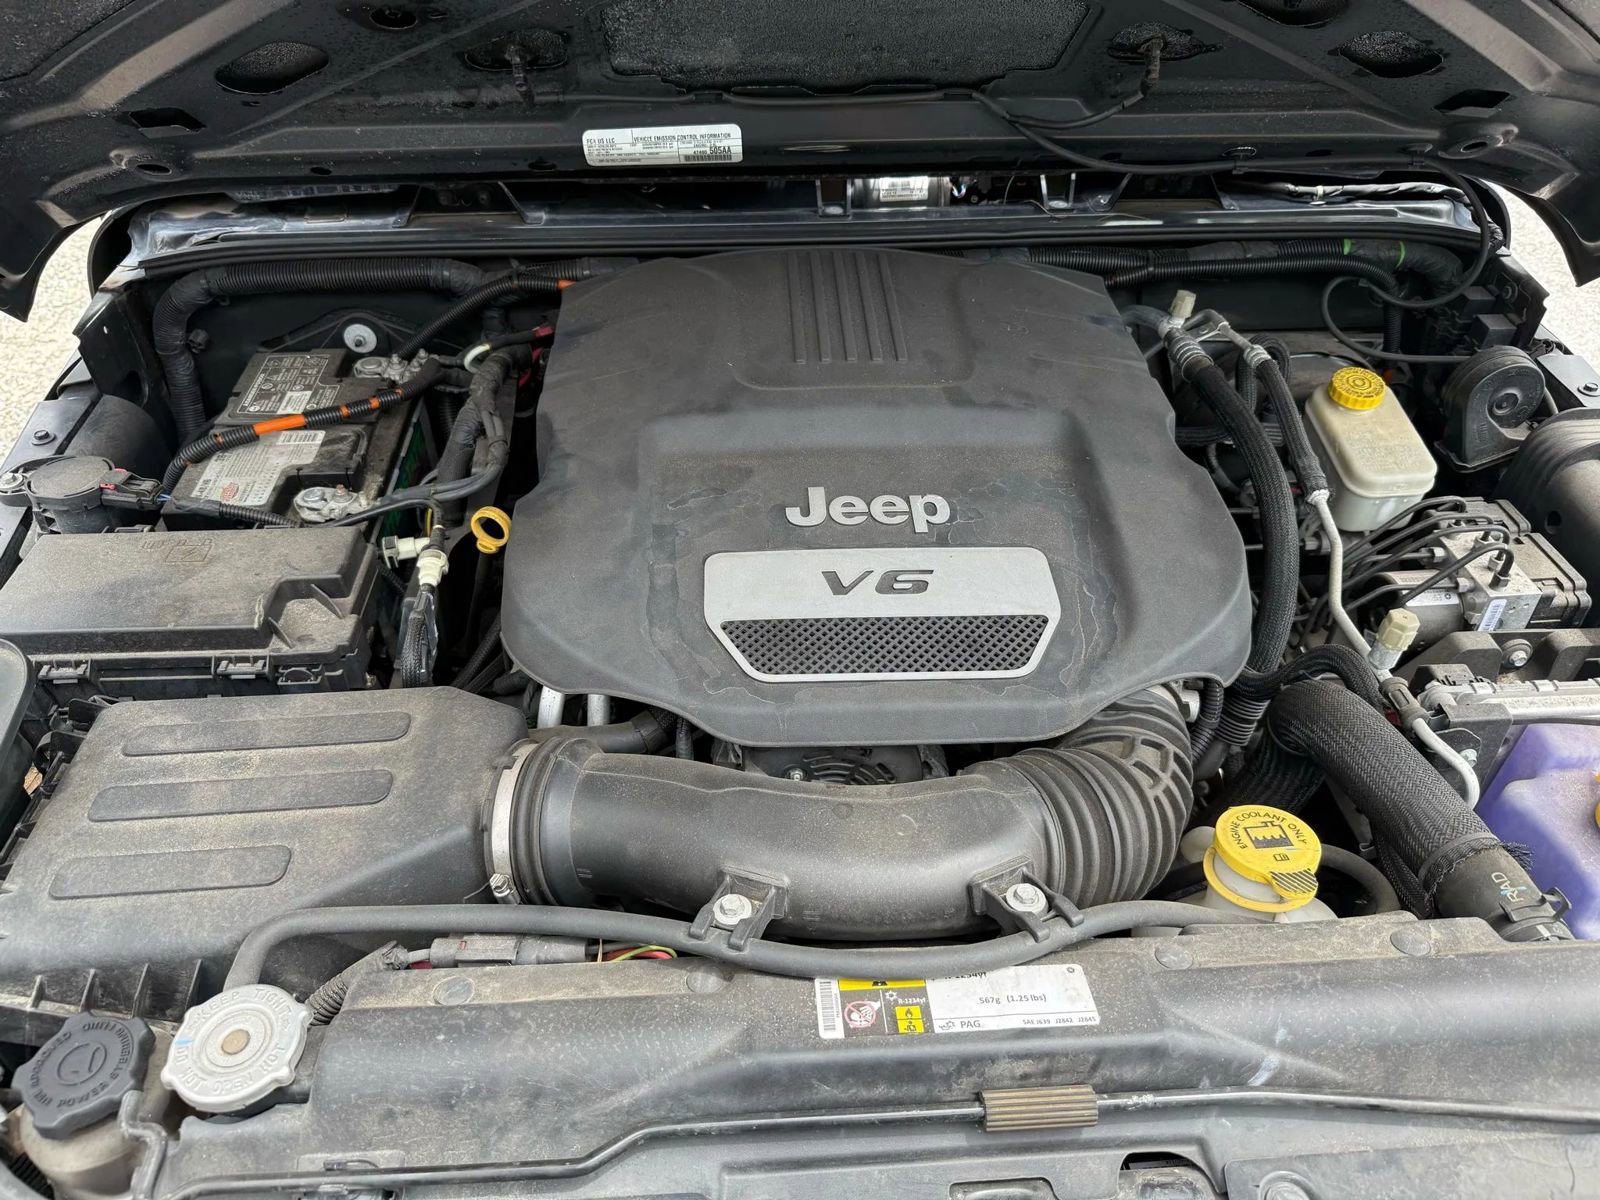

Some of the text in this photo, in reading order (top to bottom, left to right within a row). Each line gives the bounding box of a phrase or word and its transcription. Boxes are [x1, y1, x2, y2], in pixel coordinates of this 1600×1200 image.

[699, 132, 731, 140] INFORMATION
[709, 146, 732, 155] 505AA
[785, 486, 951, 534] Jeep
[821, 569, 934, 596] V6
[1230, 811, 1307, 850] ENGINE COOLANT ONLY
[197, 988, 292, 1021] KEEP TIGHT
[1006, 994, 1030, 1003] (1.25
[1030, 993, 1047, 1003] lbs)
[960, 1019, 981, 1029] PAG
[56, 1021, 131, 1108] POWER STEERING FLUID
[260, 1042, 286, 1075] HOT
